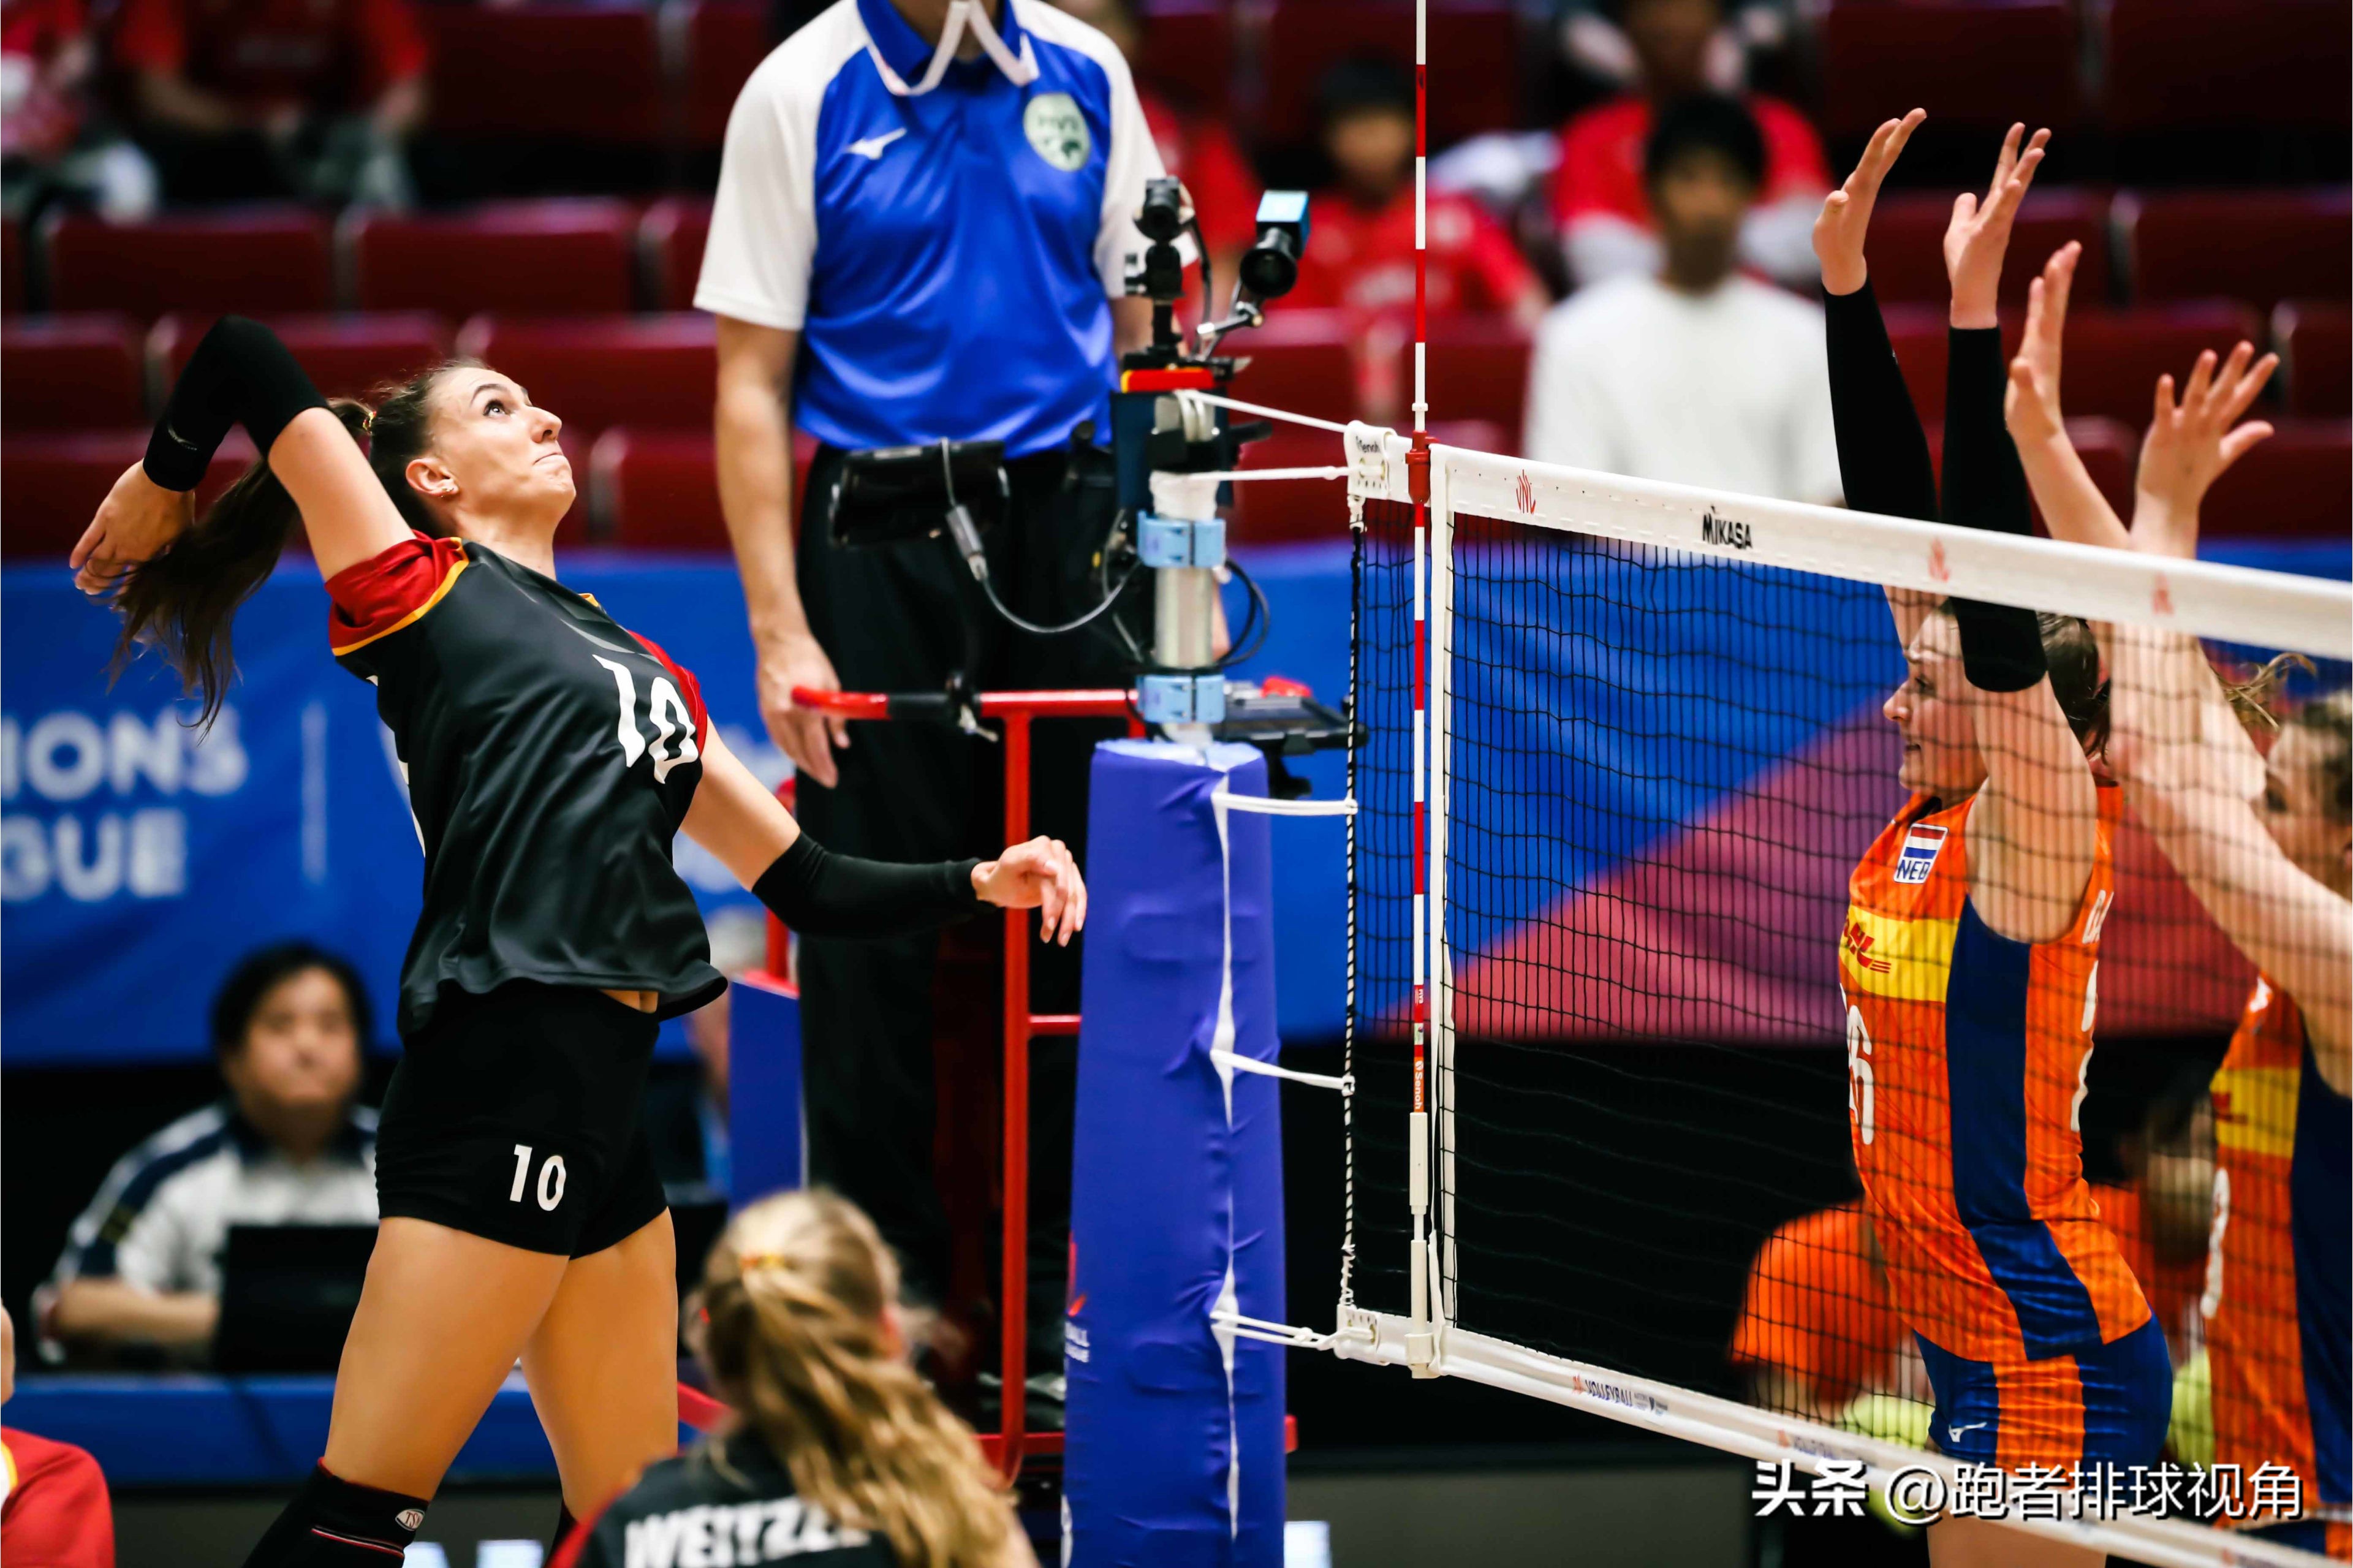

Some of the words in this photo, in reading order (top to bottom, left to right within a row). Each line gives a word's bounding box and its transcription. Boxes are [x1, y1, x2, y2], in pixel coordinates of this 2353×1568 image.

[1702, 505, 1753, 550] MIKASA
[592, 653, 699, 784] 10
[1414, 1070, 1423, 1110] Senoh
[509, 1143, 567, 1211] 10
[1585, 1379, 1633, 1407] VOLLEYBALL
